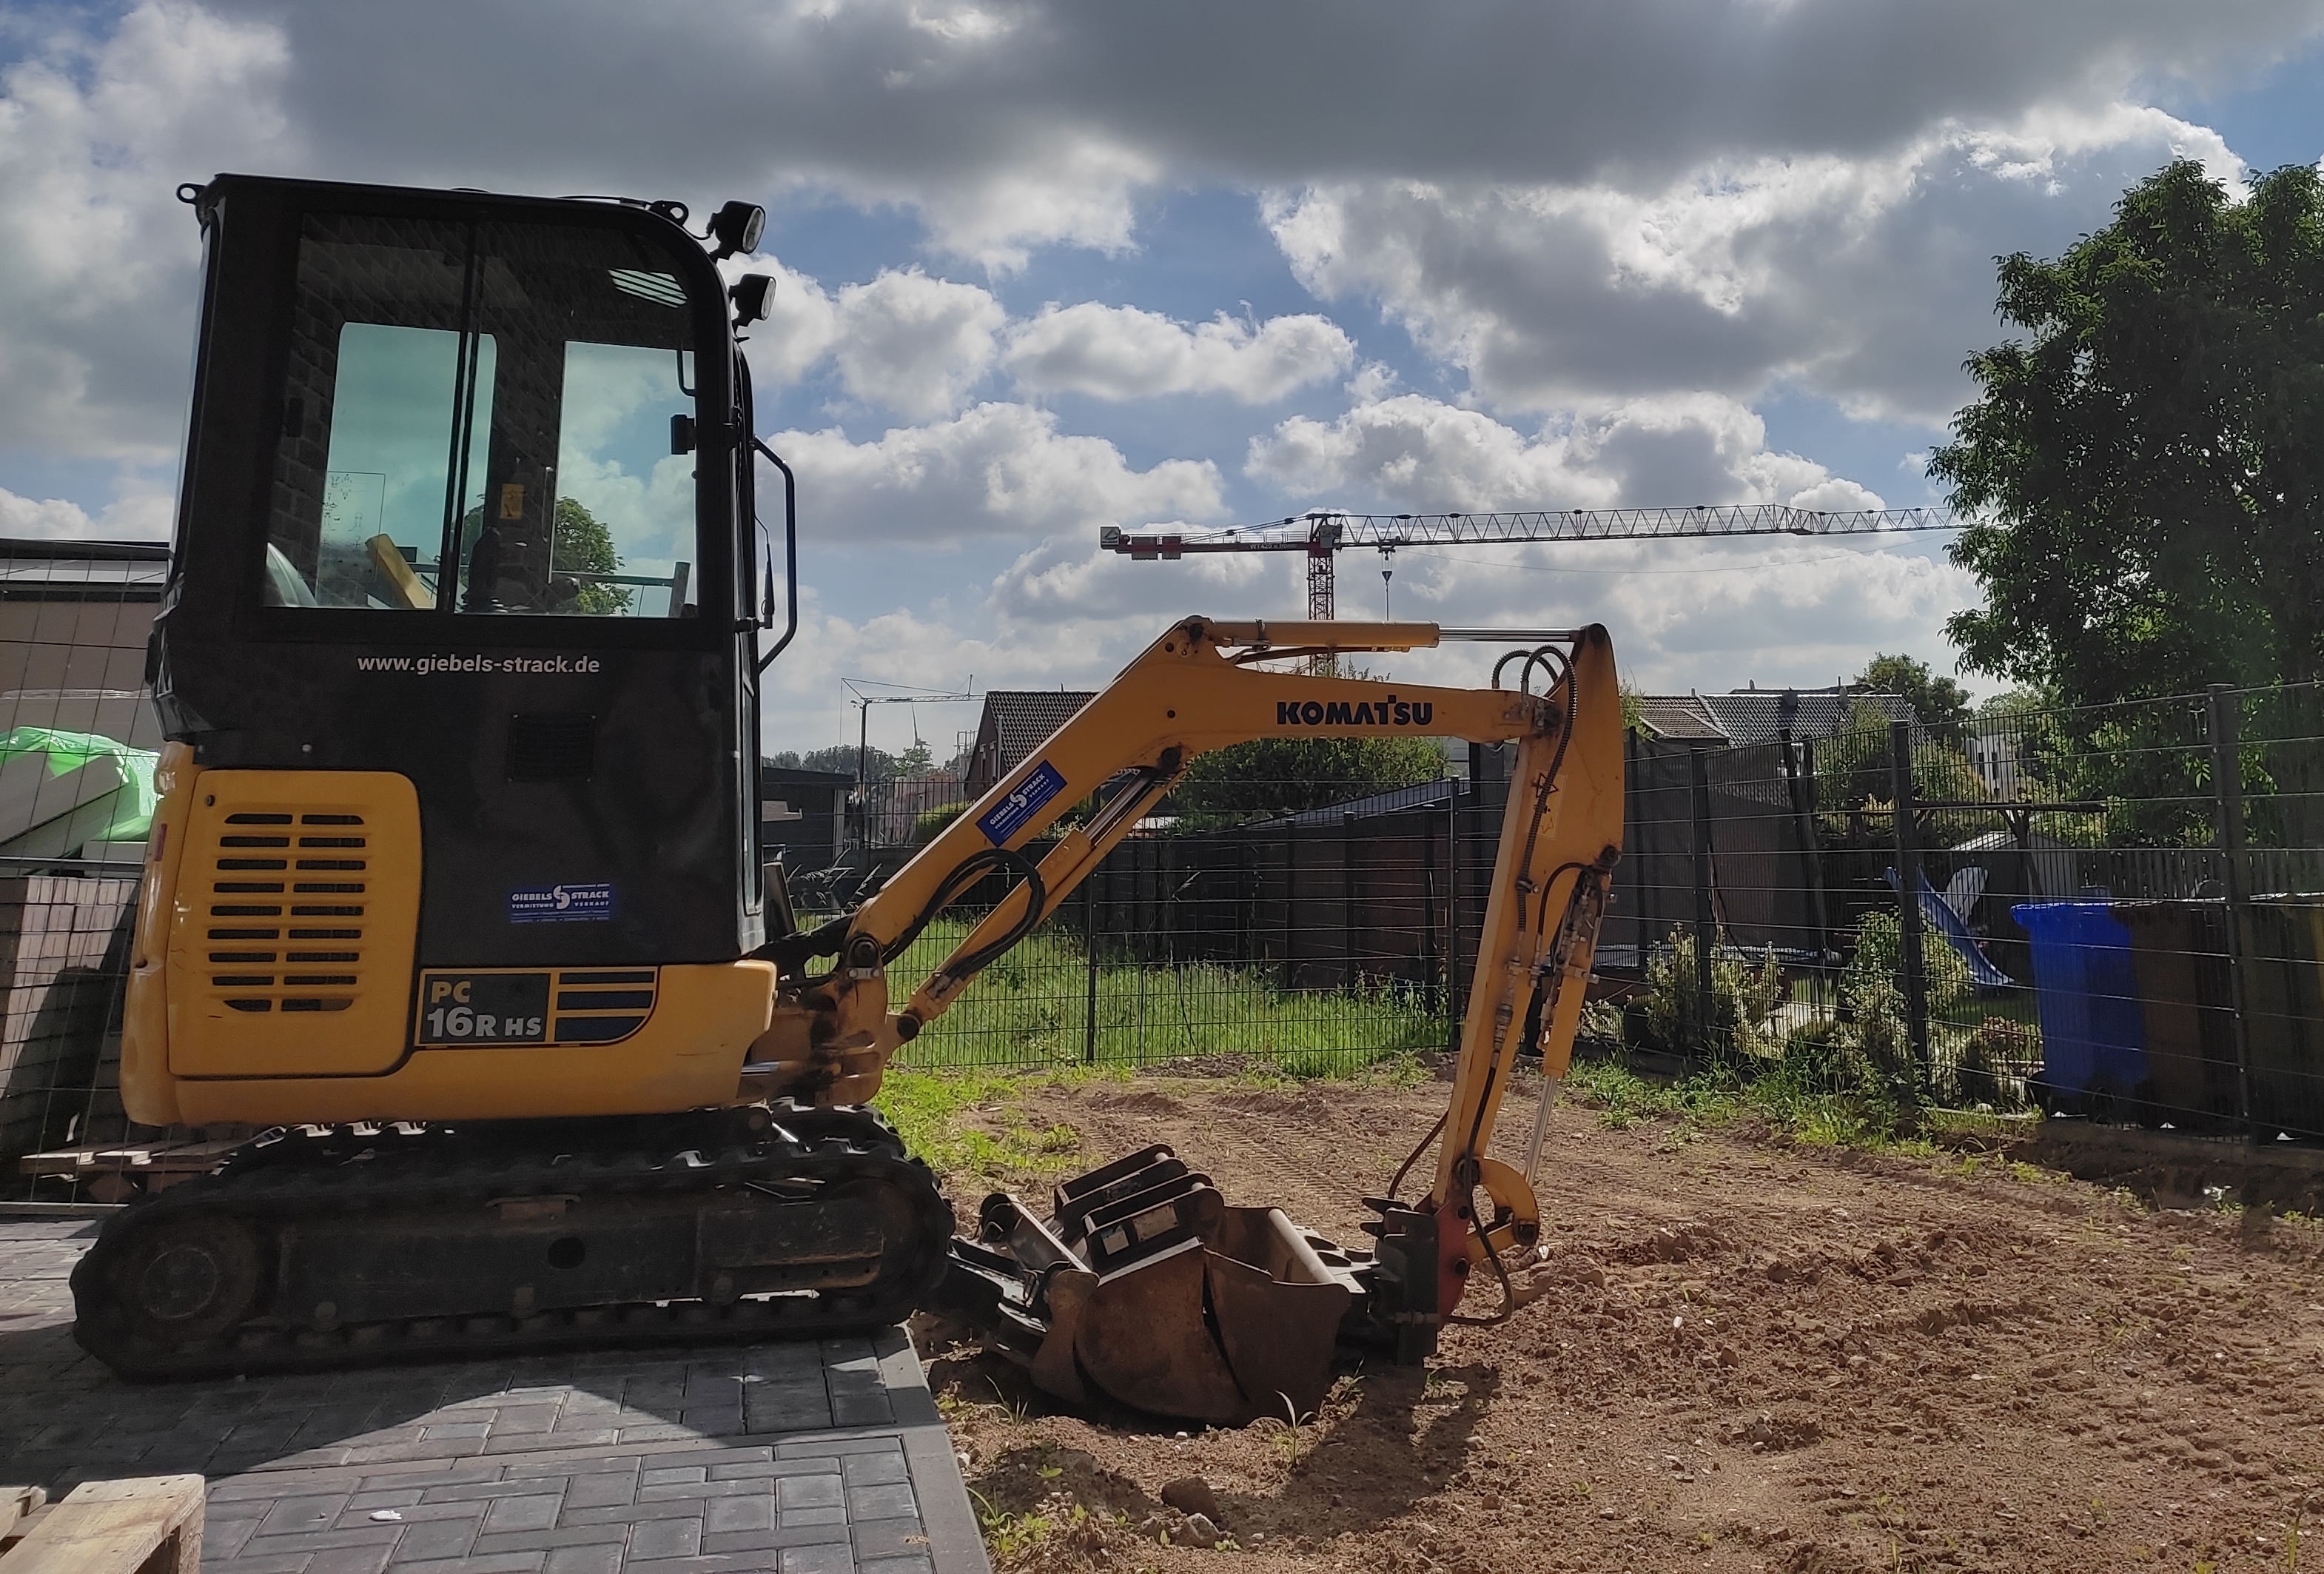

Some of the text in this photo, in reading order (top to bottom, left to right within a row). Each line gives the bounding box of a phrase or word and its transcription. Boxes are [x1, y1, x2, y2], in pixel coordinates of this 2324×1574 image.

[357, 654, 600, 675] www.giebels-strack.de
[1277, 695, 1433, 726] KOMATSU
[990, 802, 1014, 825] GIEBELS
[1022, 773, 1046, 795] STRACK
[511, 891, 610, 902] GIEBELS STRACK
[431, 980, 471, 1003] PC
[427, 1006, 541, 1037] 16R HS
